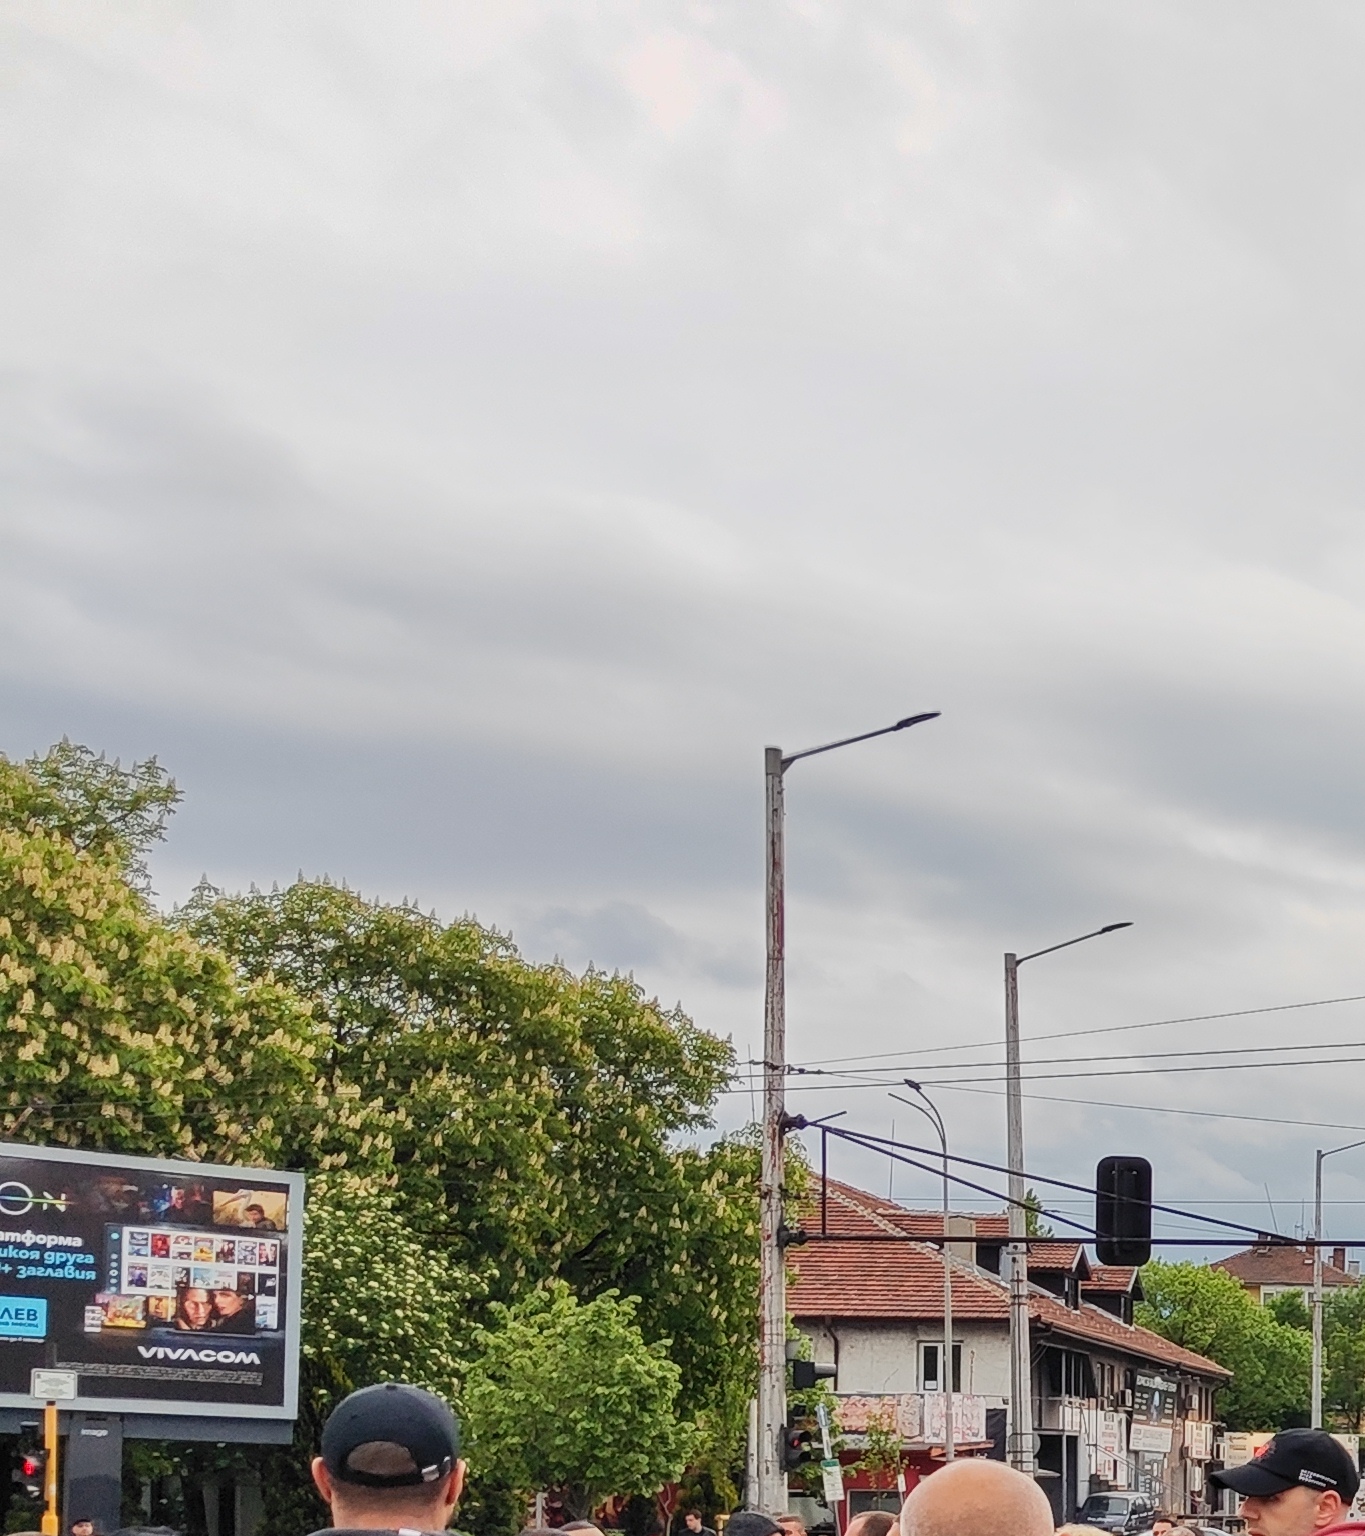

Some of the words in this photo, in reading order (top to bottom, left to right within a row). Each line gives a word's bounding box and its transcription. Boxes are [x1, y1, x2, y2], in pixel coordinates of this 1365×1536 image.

[0, 1229, 83, 1248] тформа
[43, 1251, 95, 1266] друга
[16, 1265, 97, 1280] заглавия
[138, 1346, 261, 1365] VIVACOM
